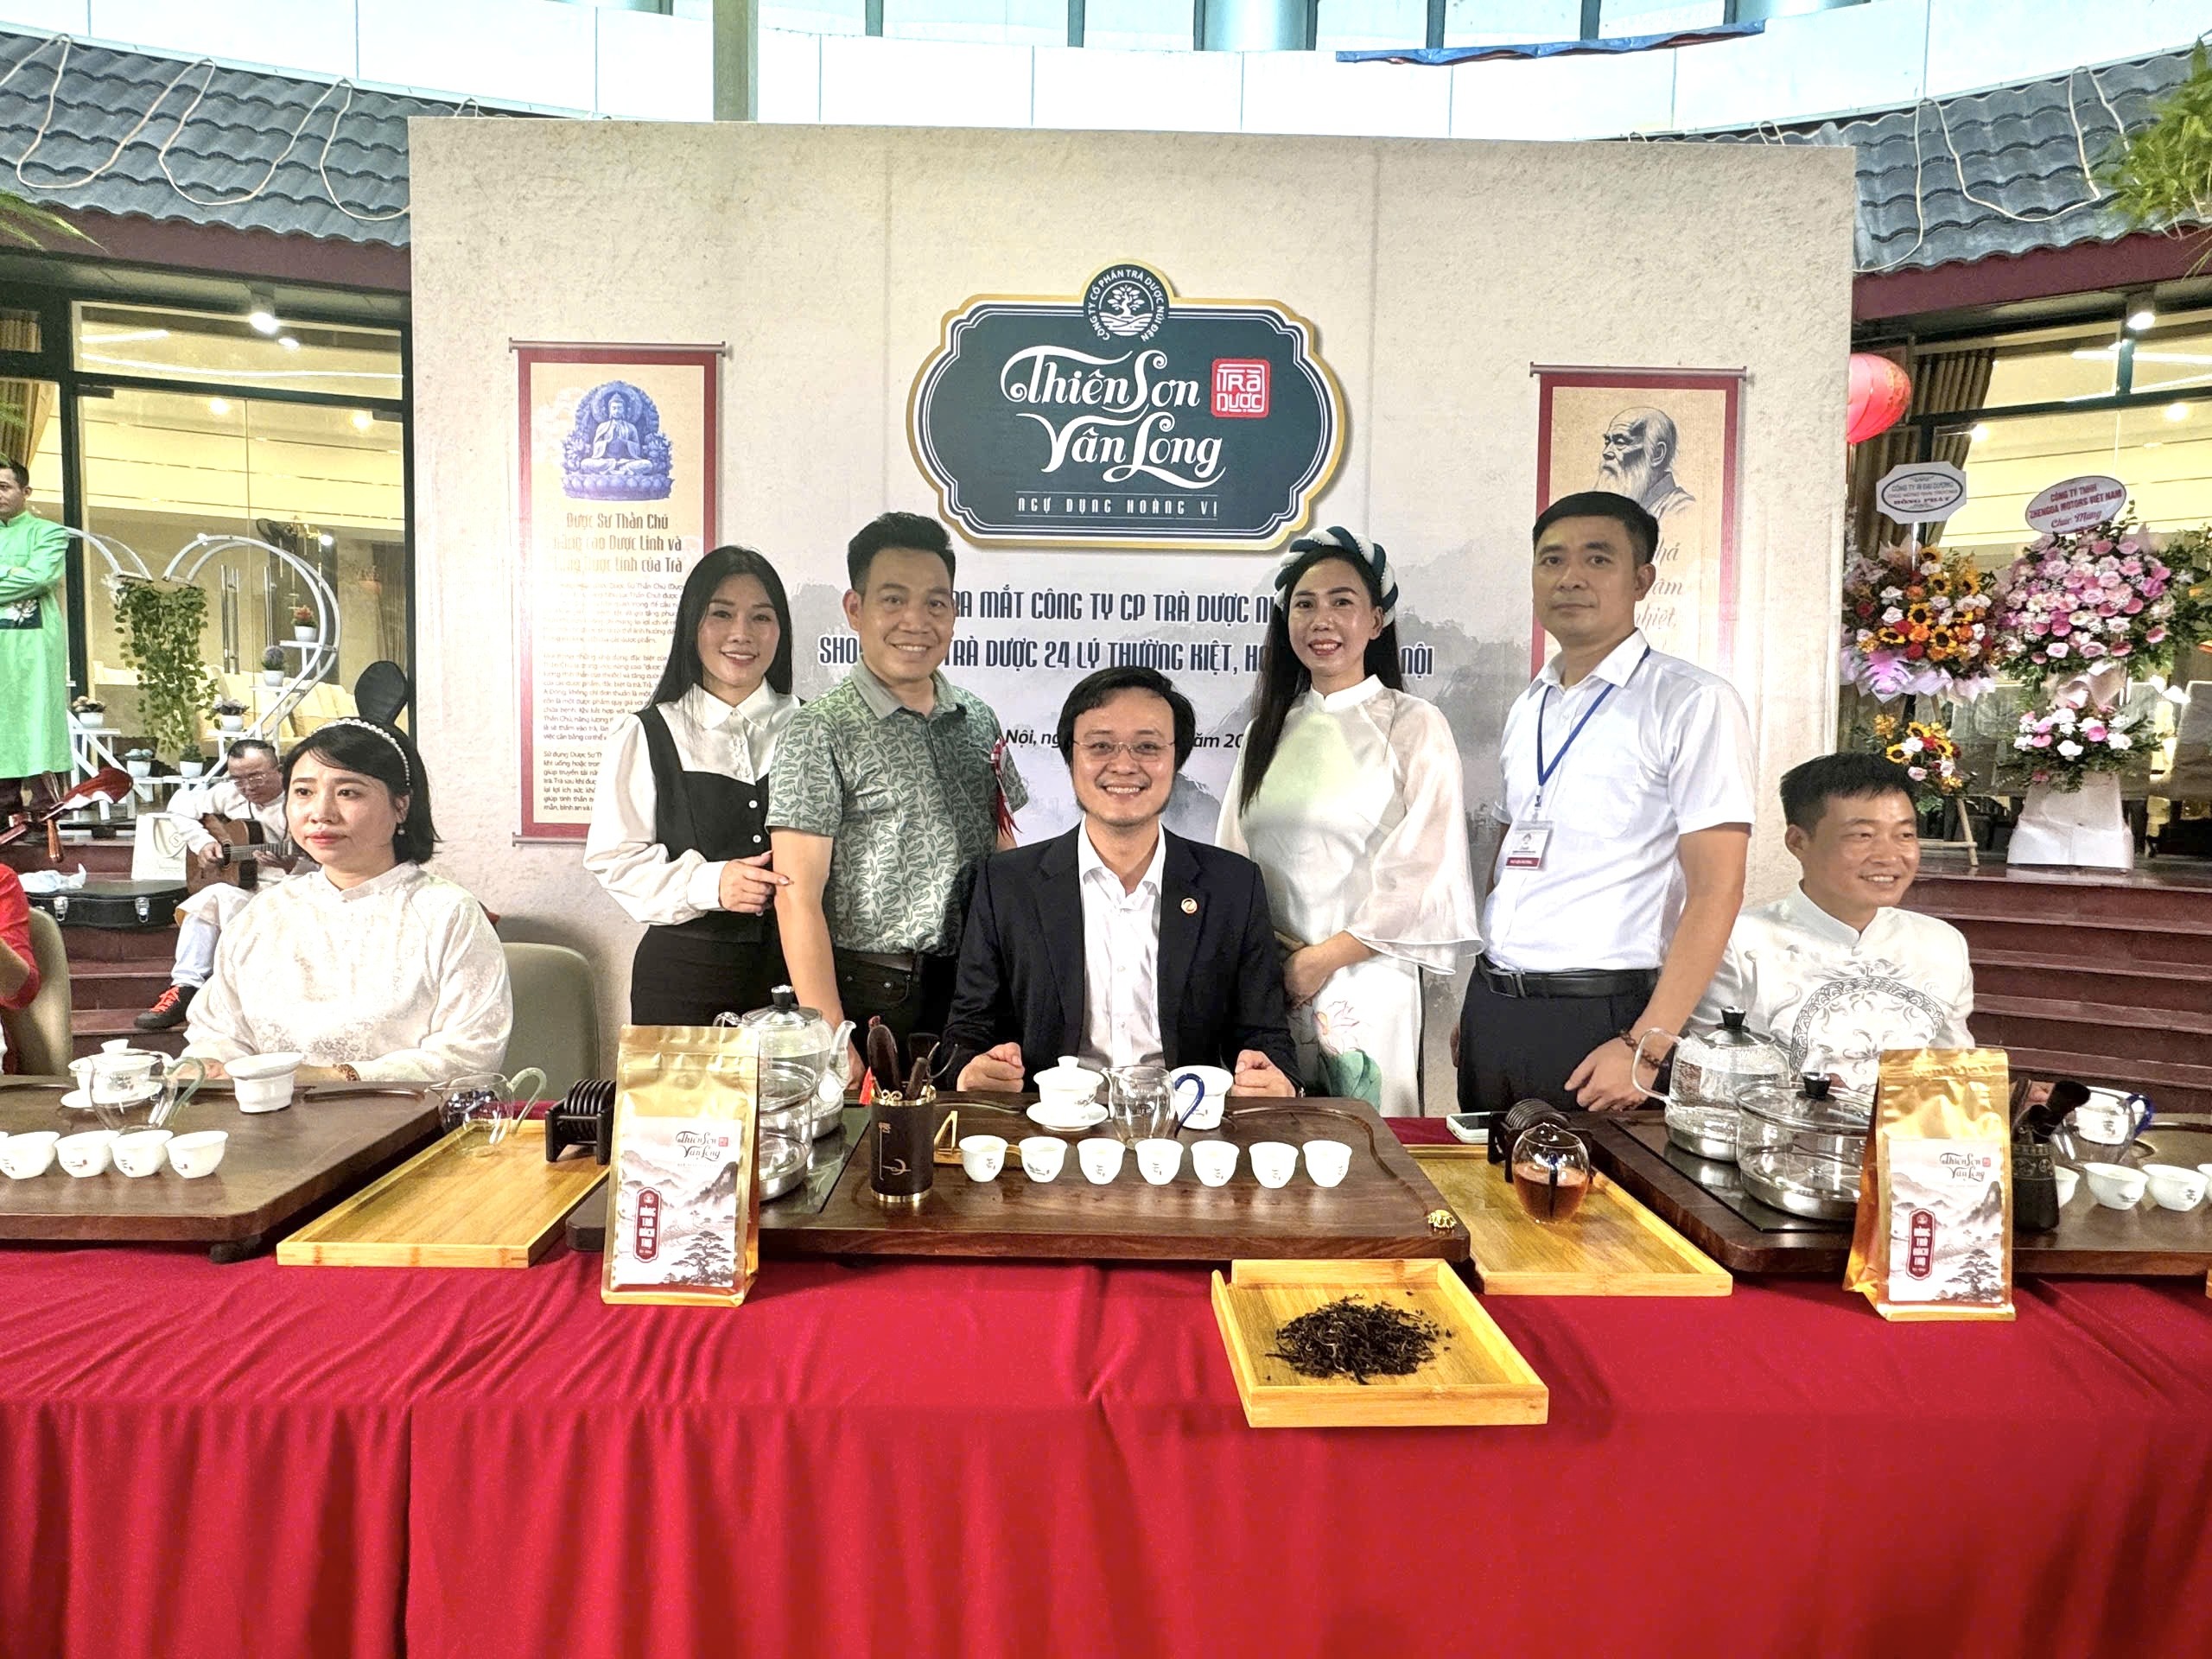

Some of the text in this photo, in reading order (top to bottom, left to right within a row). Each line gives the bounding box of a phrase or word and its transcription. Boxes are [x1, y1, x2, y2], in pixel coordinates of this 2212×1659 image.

[1088, 302, 1096, 315] TY
[1089, 315, 1110, 340] CÔNG
[1000, 346, 1200, 414] Thiên Sơn
[1016, 404, 1226, 490] Vân Long
[2060, 497, 2088, 512] MOTORS
[2105, 488, 2122, 501] NAM
[2070, 488, 2078, 498] TY
[1018, 497, 1217, 518] NGỰ DỤNG HOÀNG VỊ
[598, 513, 613, 529] Sư
[610, 535, 637, 552] Dược
[669, 536, 683, 551] và
[1656, 536, 1681, 567] há
[1652, 578, 1682, 595] âm
[980, 587, 1024, 618] MẮT
[1032, 588, 1082, 620] CÔNG
[1090, 593, 1113, 620] TY
[1121, 594, 1146, 621] CP
[1153, 591, 1189, 621] TRÀ
[1197, 593, 1249, 627] DƯỢC
[820, 637, 857, 664] SHO
[985, 639, 1036, 671] DƯỢC
[1045, 642, 1070, 668] 24
[1077, 638, 1100, 669] LÝ
[1108, 639, 1183, 671] THƯỜNG
[1190, 640, 1238, 675] KIỆT,
[1245, 645, 1267, 672] HO
[1401, 643, 1433, 679] NỘI
[1006, 730, 1244, 748] Nội, ng ăm 20
